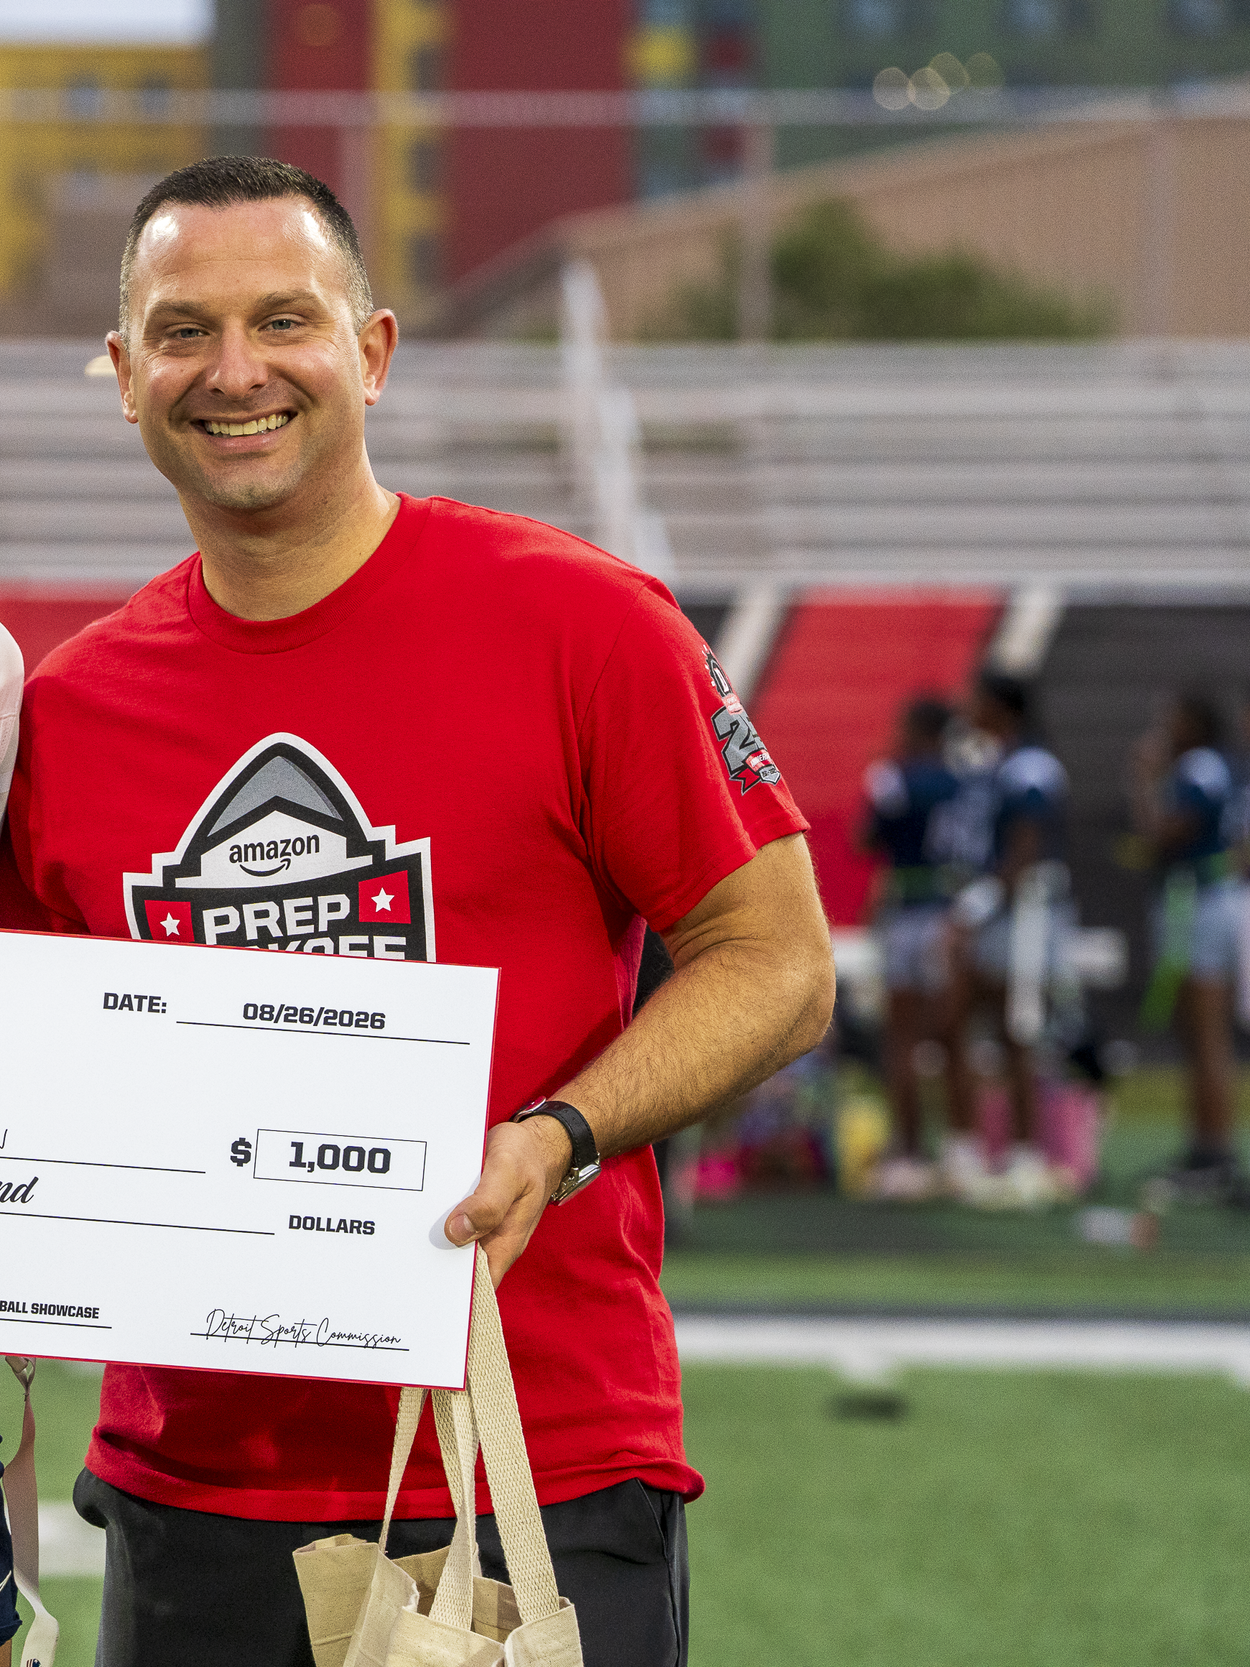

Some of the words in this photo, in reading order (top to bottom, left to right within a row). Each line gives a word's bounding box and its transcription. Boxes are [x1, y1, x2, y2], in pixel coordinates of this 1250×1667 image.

[228, 833, 320, 864] amazon
[202, 893, 351, 946] PREP
[102, 992, 167, 1014] DATE:
[242, 1002, 386, 1030] 08/26/2026
[229, 1137, 252, 1168] $
[288, 1141, 392, 1174] 1,000
[288, 1214, 376, 1236] DOLLARS
[30, 1302, 100, 1320] SHOWCASE
[206, 1308, 258, 1344] Detroit
[260, 1313, 314, 1348] Sports
[316, 1317, 402, 1349] Commission
